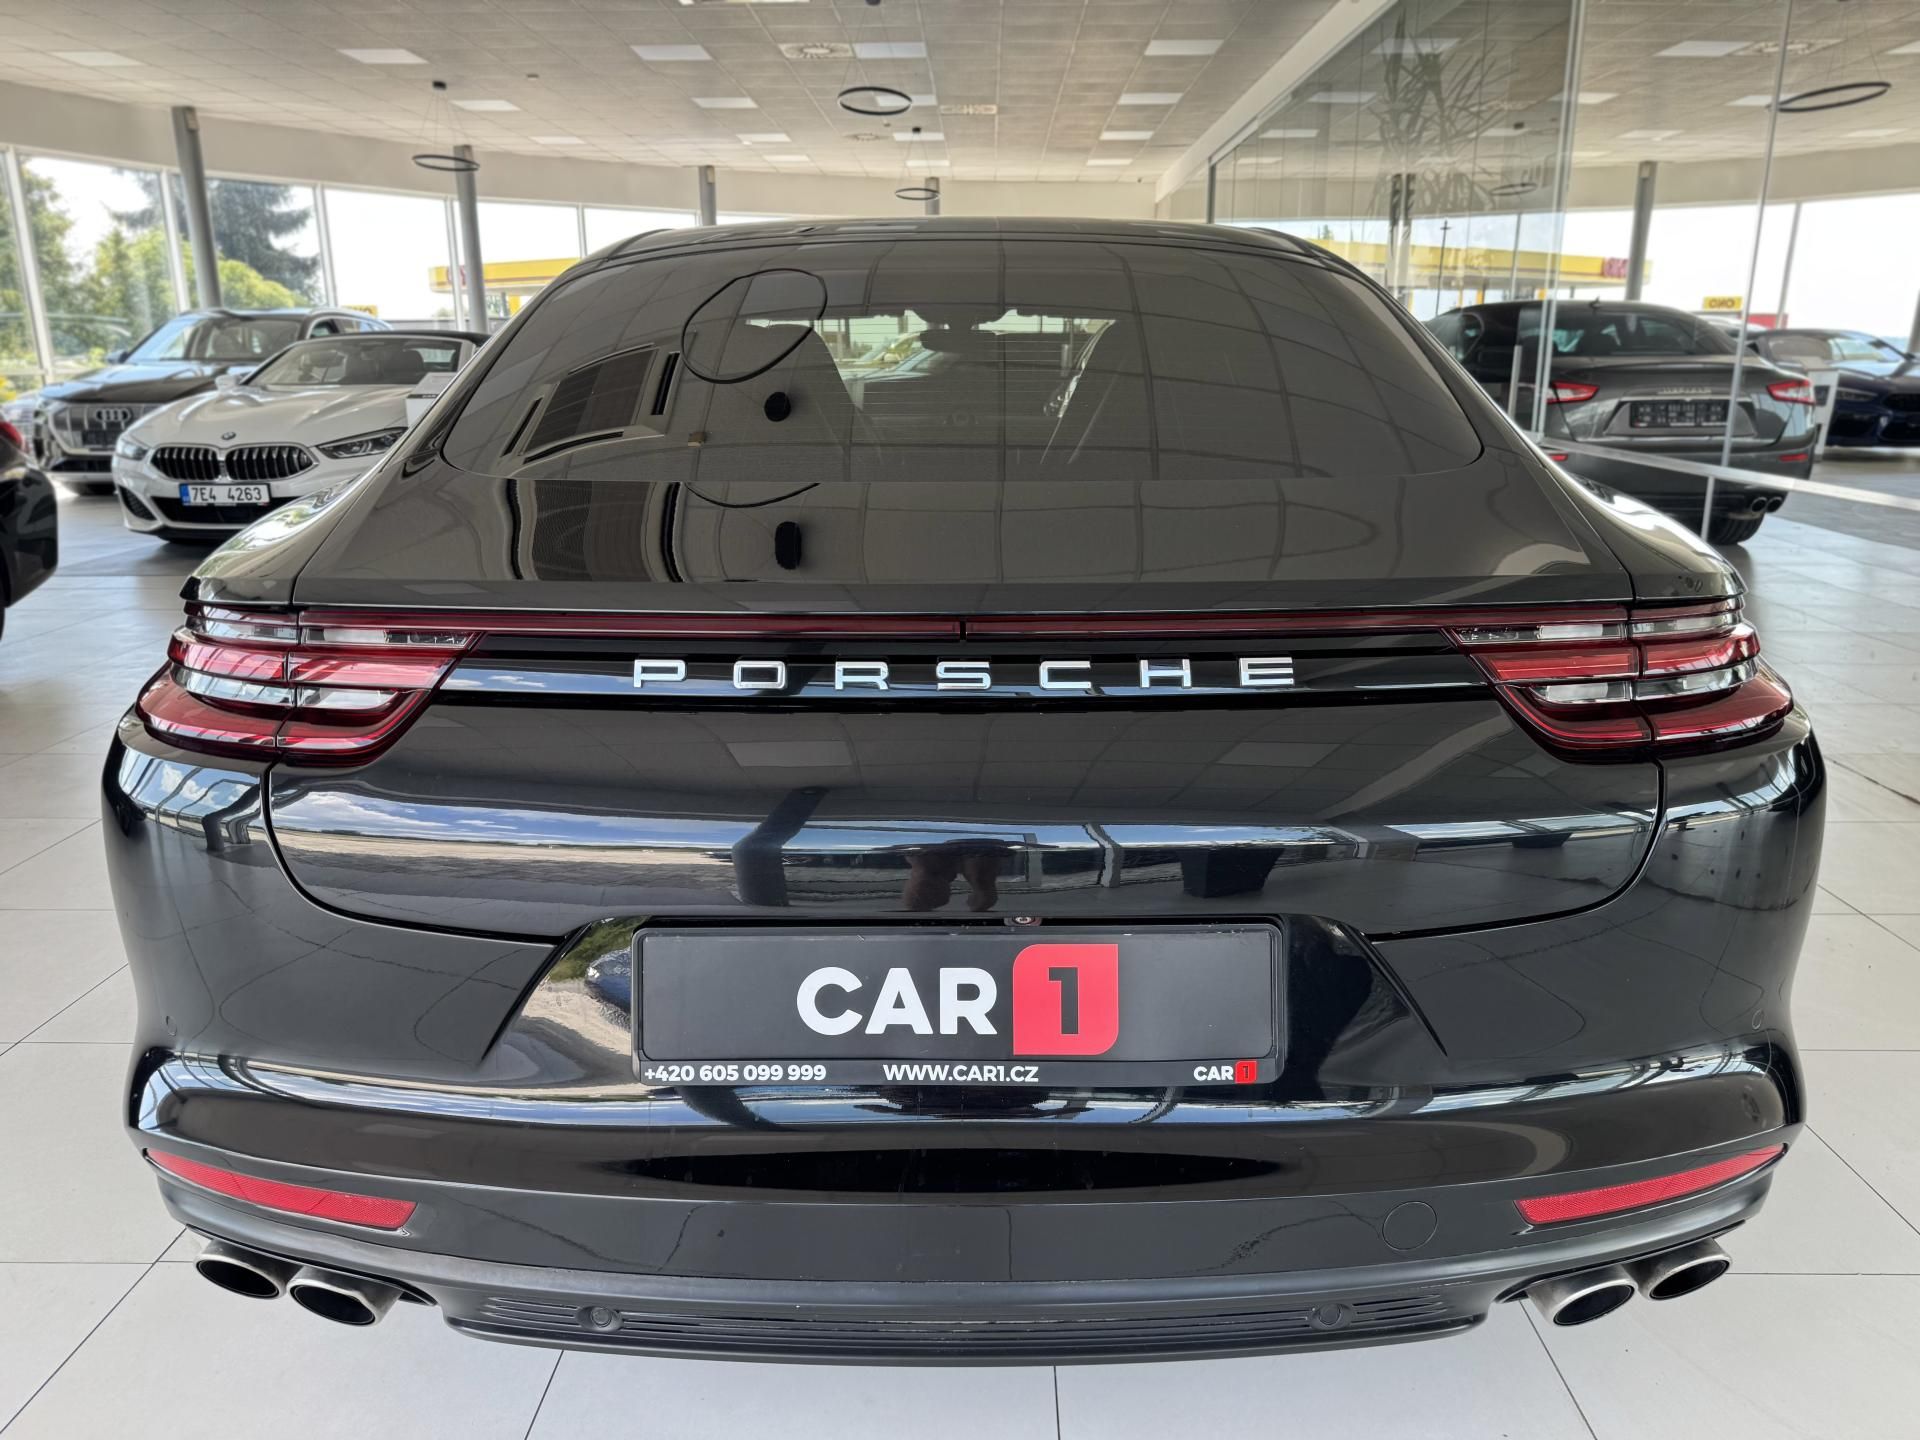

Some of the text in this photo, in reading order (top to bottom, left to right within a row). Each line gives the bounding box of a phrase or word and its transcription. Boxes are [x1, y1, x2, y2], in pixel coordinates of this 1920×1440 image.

[191, 487, 262, 501] 7E4 4263
[633, 656, 1295, 691] PORSCHE
[644, 1064, 827, 1082] +420 605 099 999
[882, 1064, 1039, 1083] WWW.CAR1.CZ
